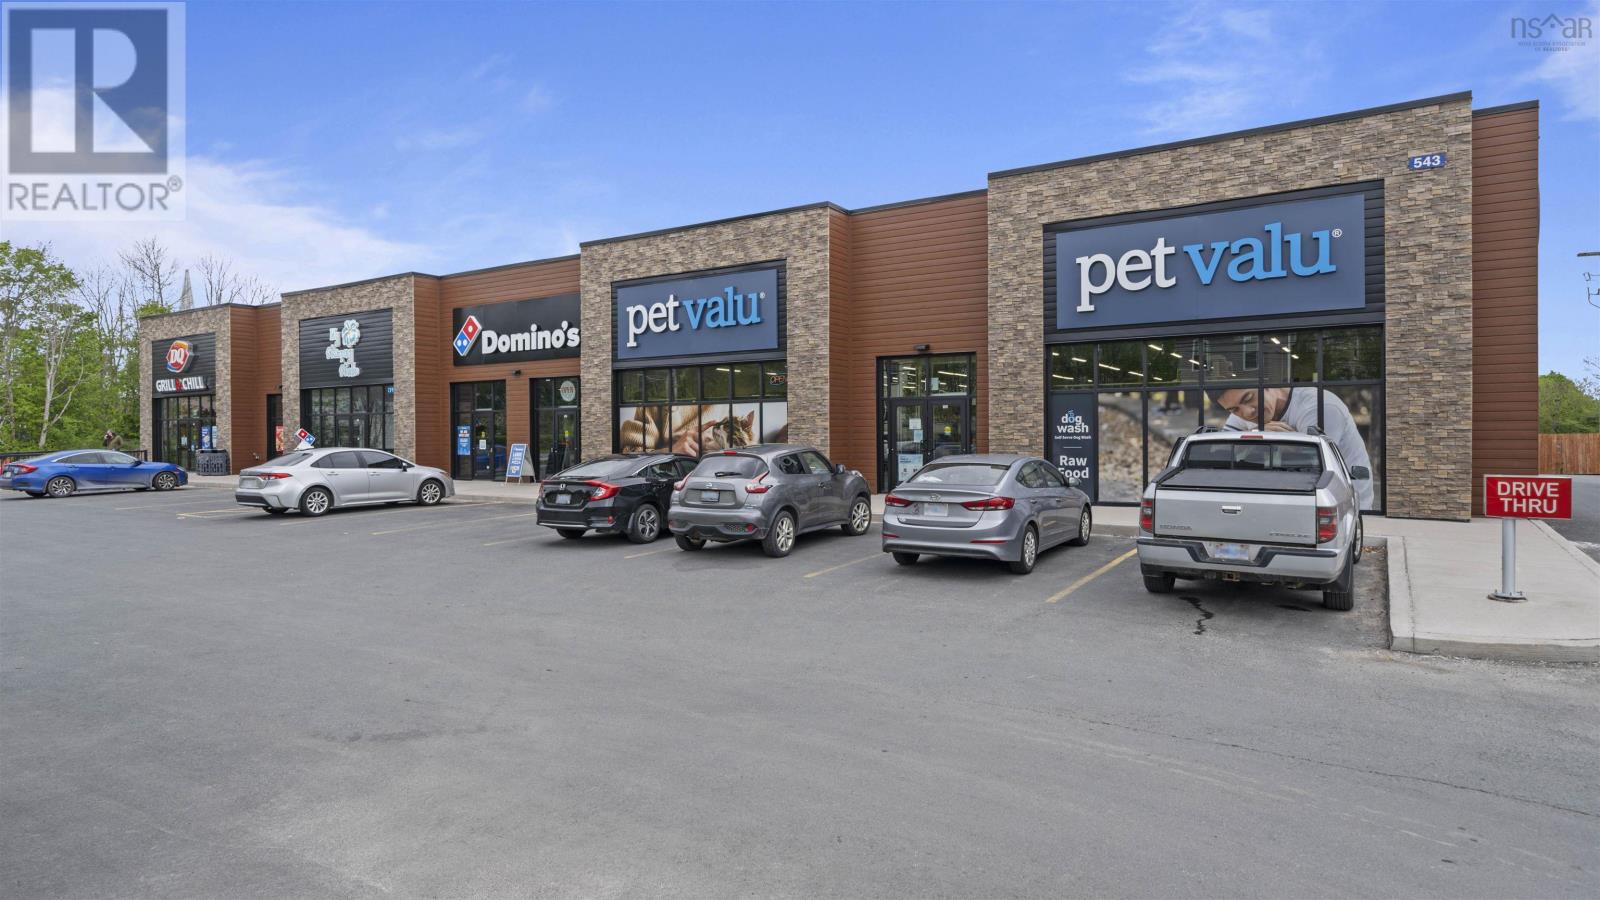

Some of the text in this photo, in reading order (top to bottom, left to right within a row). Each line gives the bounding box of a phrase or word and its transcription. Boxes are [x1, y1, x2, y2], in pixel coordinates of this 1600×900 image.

[1413, 155, 1441, 168] 543
[1076, 237, 1176, 312] pet
[626, 294, 680, 348] pet
[481, 320, 580, 354] Domino's
[170, 348, 184, 364] DQ
[155, 378, 176, 392] GRILL
[182, 376, 204, 390] CHILL
[1061, 413, 1082, 425] dog
[1057, 423, 1089, 434] wash
[1060, 456, 1087, 466] Raw
[1497, 481, 1559, 497] DRIVE
[1500, 498, 1557, 513] THRU
